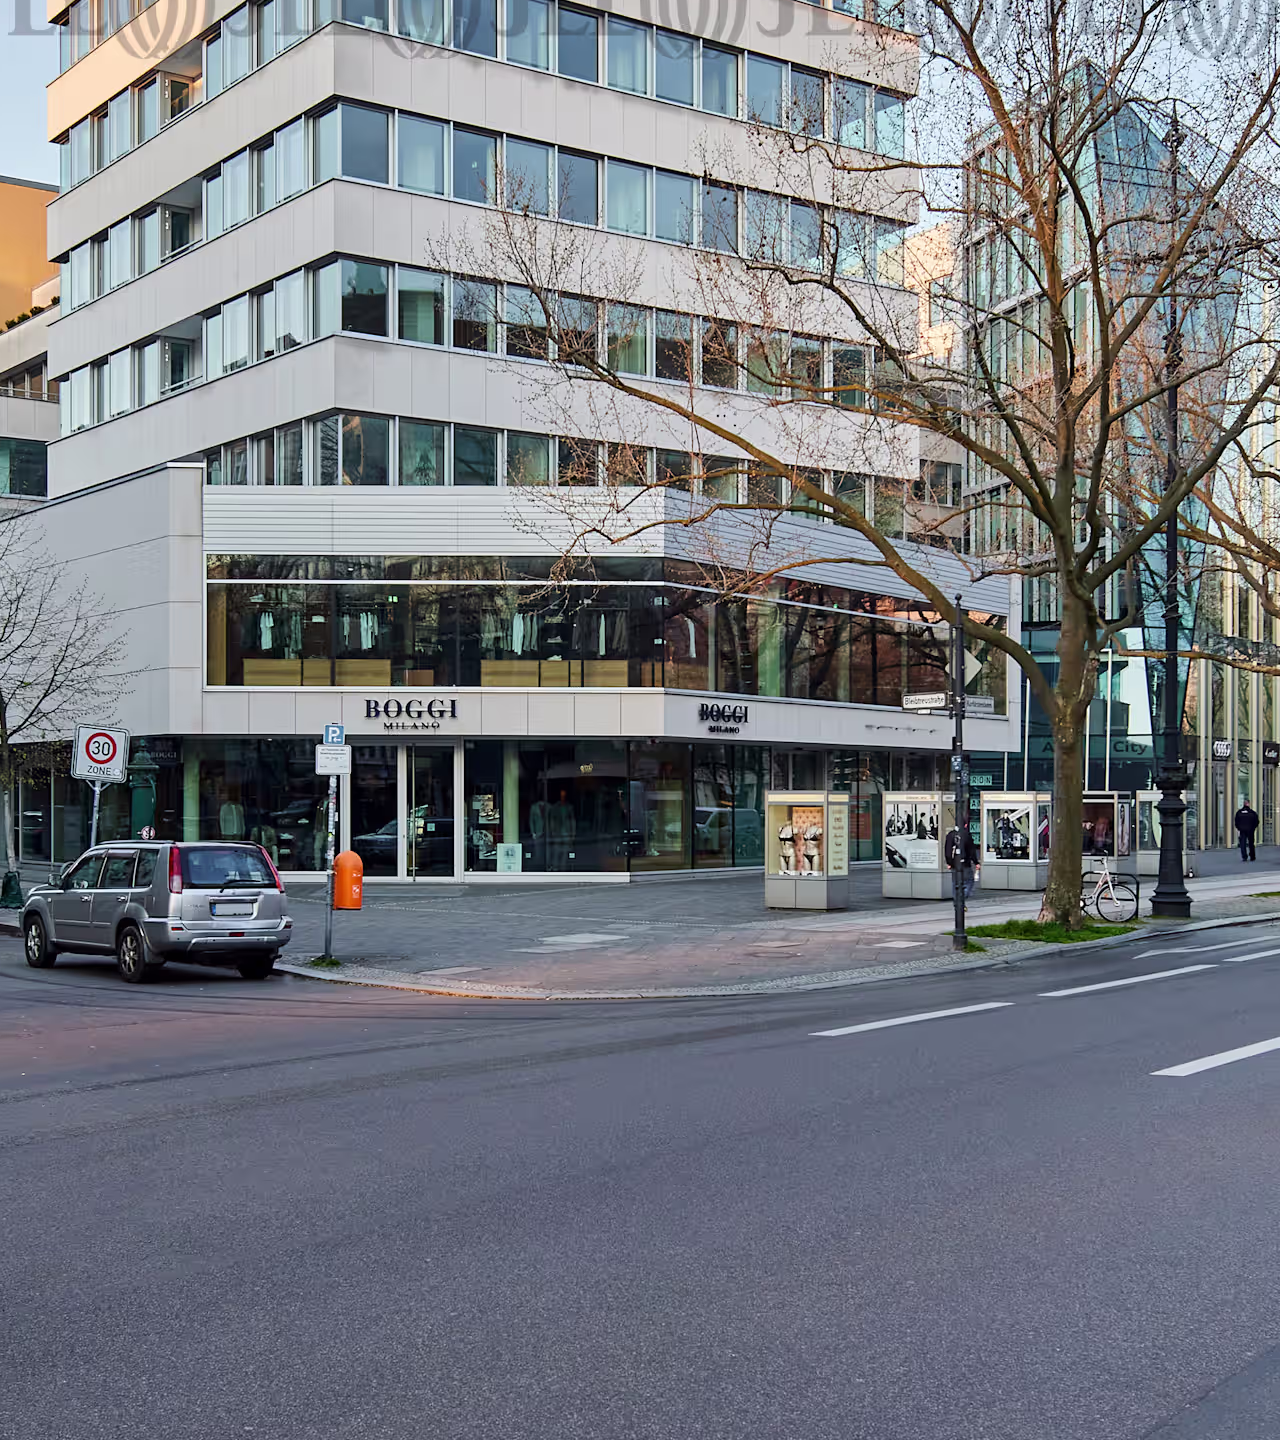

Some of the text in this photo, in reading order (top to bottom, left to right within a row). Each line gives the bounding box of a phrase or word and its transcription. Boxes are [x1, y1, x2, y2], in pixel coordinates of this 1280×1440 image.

[364, 698, 458, 719] BOGGI
[699, 703, 749, 723] BOGGI
[383, 721, 440, 730] MILANO
[708, 725, 740, 734] MILANO
[328, 726, 340, 743] P
[91, 741, 111, 756] 30
[1113, 741, 1148, 755] City
[87, 765, 112, 775] ZONE
